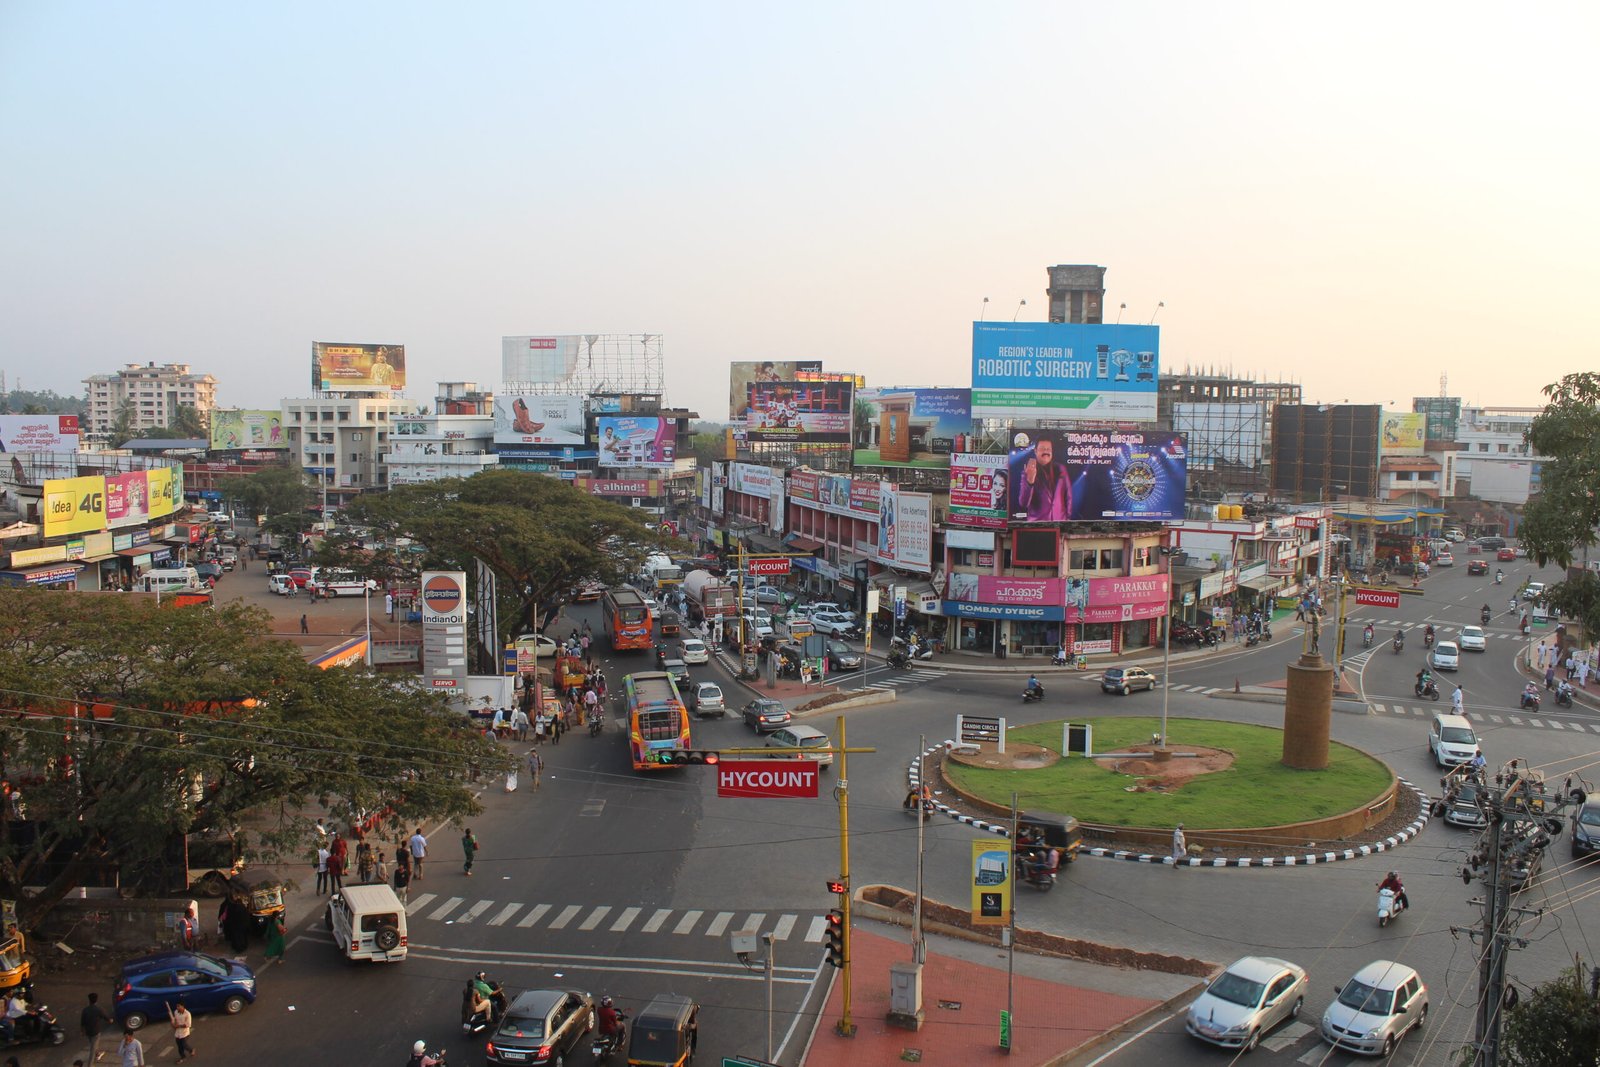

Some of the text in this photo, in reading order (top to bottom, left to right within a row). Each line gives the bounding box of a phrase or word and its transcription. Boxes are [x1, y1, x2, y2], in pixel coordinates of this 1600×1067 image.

[999, 346, 1073, 358] REGION'S LEADER IN
[978, 359, 1092, 378] ROBOTIC SURGERY
[163, 482, 171, 499] 4G
[603, 483, 636, 492] alhind
[79, 493, 102, 513] 4G
[109, 497, 123, 508] small
[923, 522, 928, 534] 44
[1296, 519, 1315, 528] LODGE
[750, 562, 788, 572] HYCOUNT
[1113, 581, 1156, 592] PARAKKAT
[1357, 593, 1398, 604] HYCOUNT
[958, 604, 1044, 615] BOMBAY DYEING
[721, 772, 814, 787] HYCOUNT
